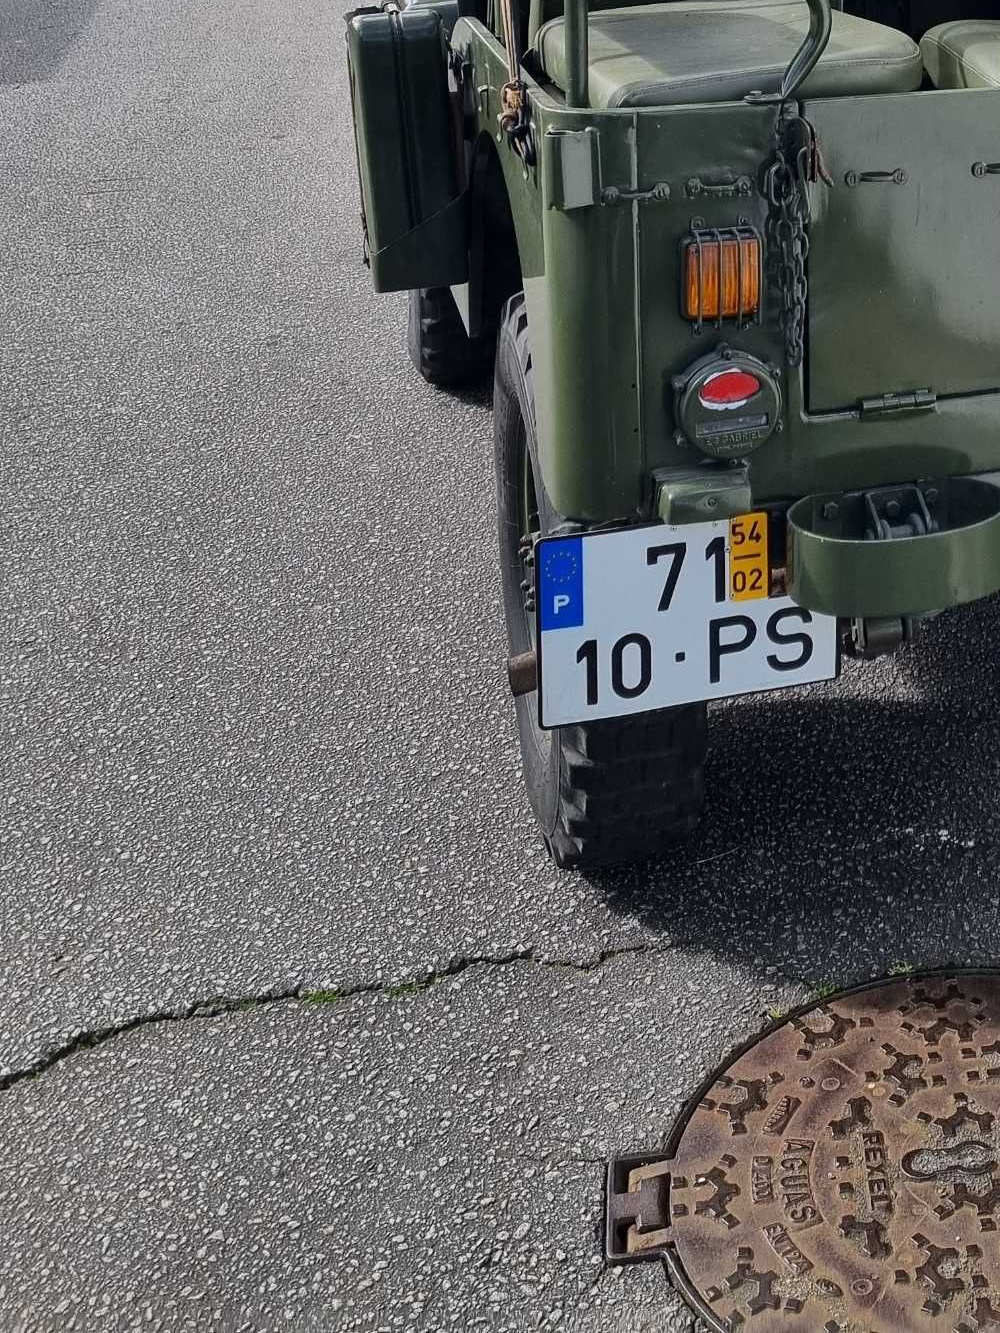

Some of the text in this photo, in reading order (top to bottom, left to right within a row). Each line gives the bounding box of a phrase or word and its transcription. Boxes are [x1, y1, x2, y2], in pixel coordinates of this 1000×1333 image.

[731, 521, 761, 545] 54
[646, 536, 727, 612] 71
[732, 568, 763, 594] 02
[553, 593, 570, 615] P
[780, 1138, 818, 1224] AGUAS
[862, 1131, 891, 1213] REXEL
